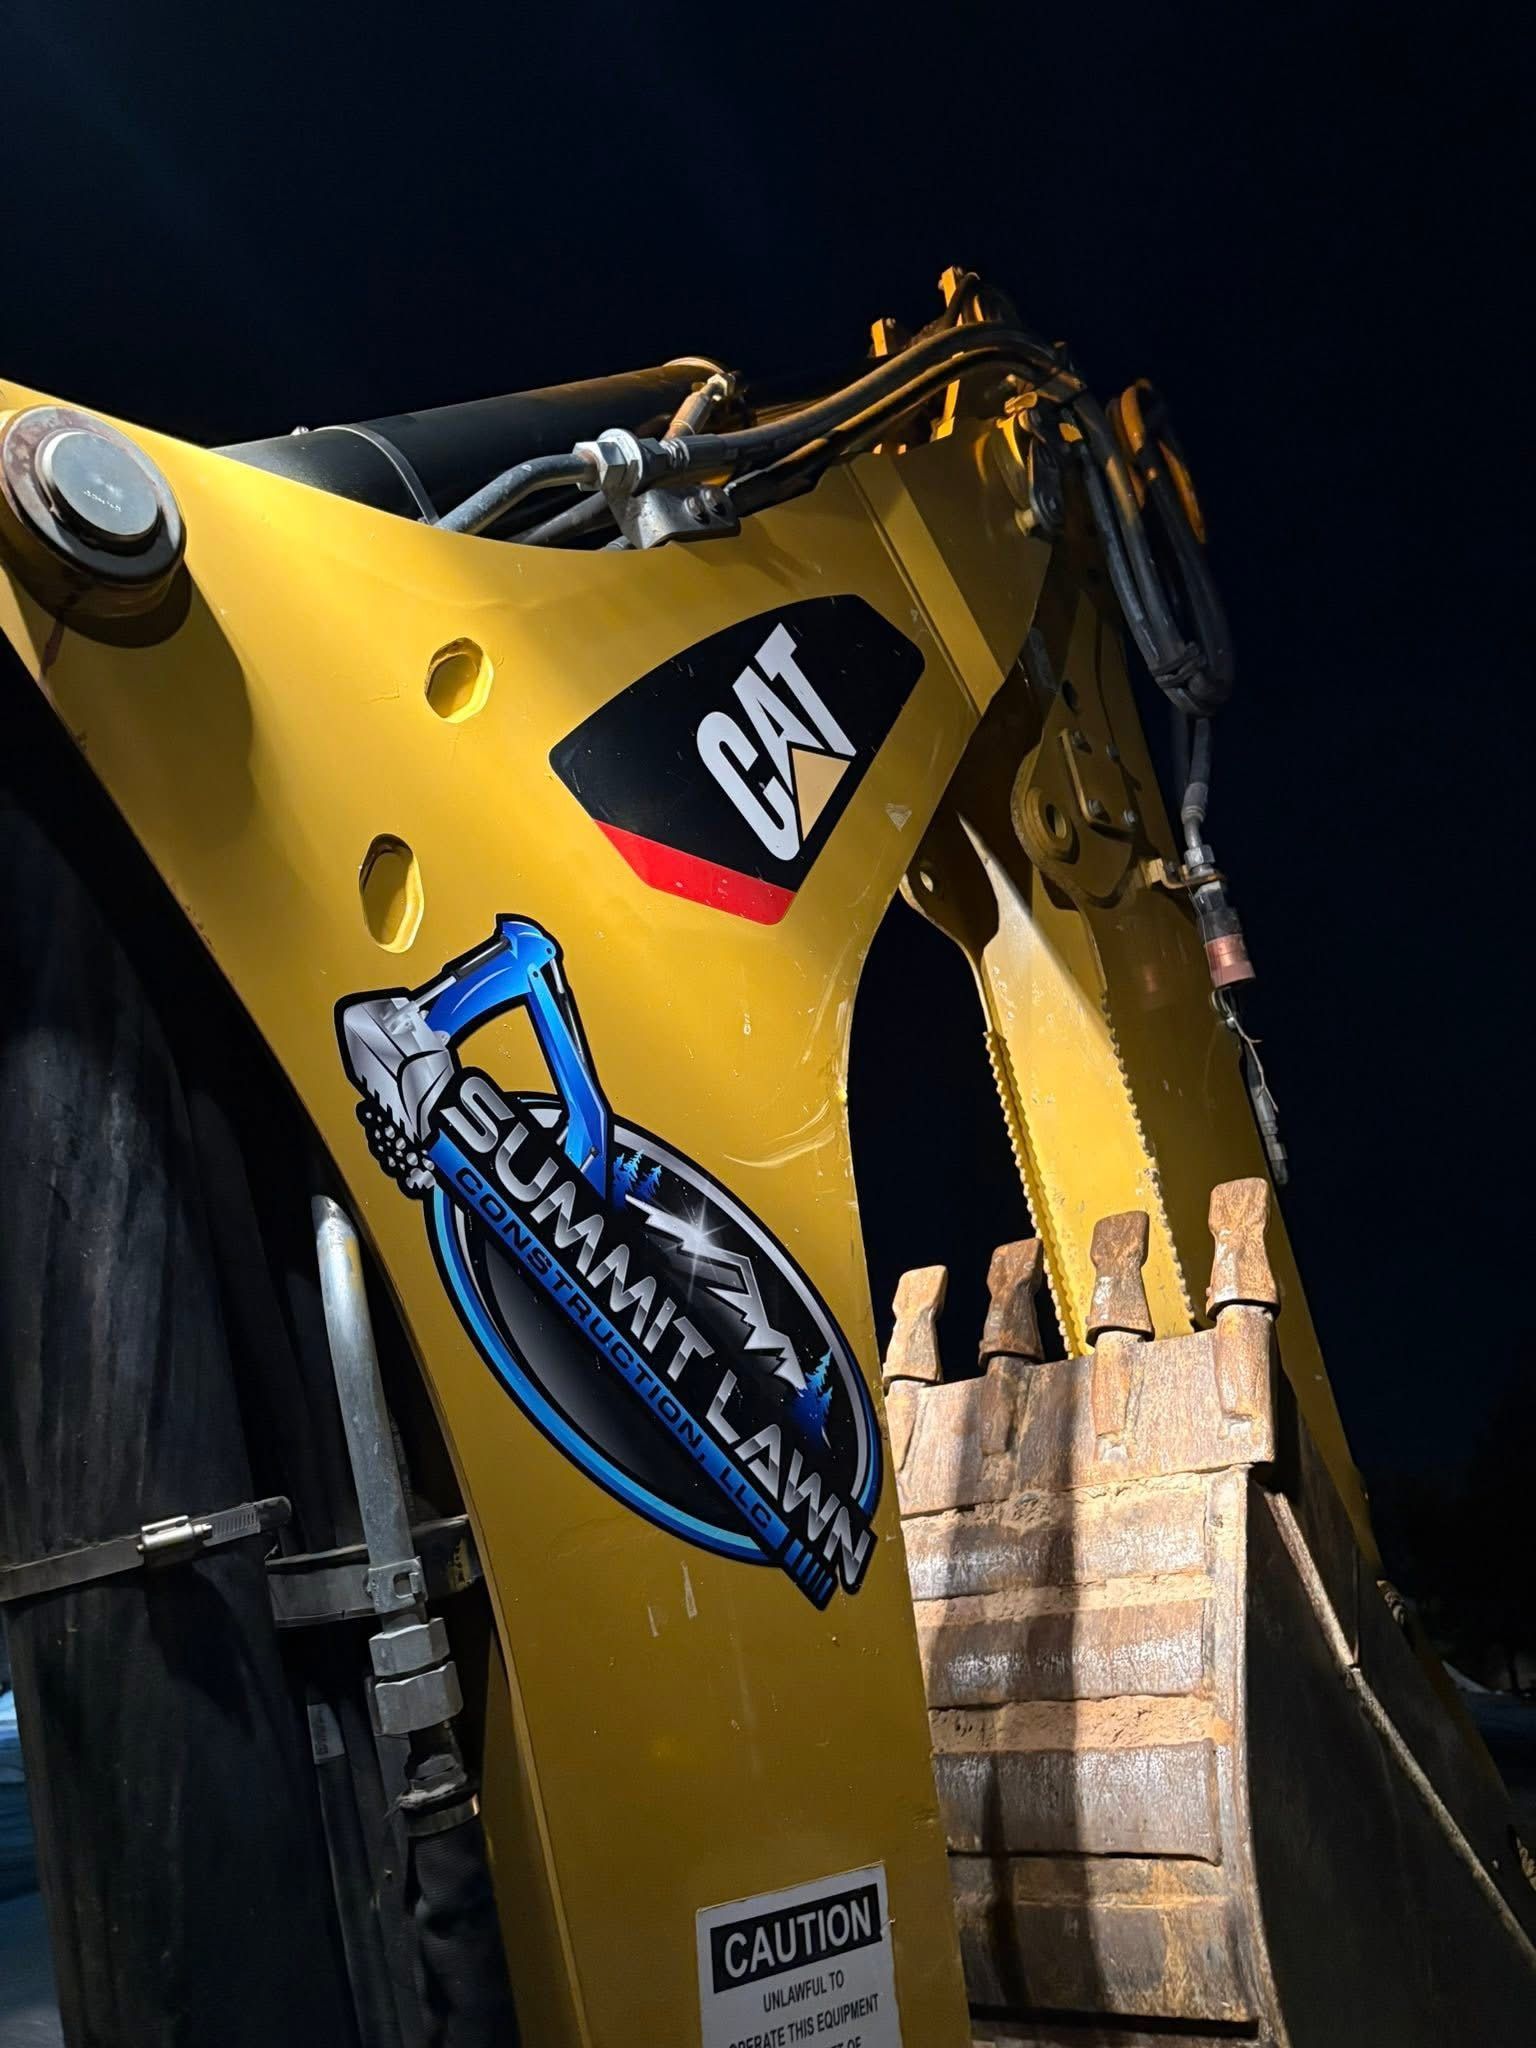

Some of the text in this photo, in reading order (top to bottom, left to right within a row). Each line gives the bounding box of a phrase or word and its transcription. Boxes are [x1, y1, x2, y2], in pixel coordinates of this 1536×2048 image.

[696, 622, 857, 861] CAT
[440, 1076, 870, 1578] SUMMIT LAWN
[719, 1466, 772, 1529] LLC
[724, 1896, 872, 1979] CAUTION
[763, 1969, 845, 2013] UNLAWFUL TO
[787, 2015, 815, 2043] THIS
[817, 1993, 879, 2033] EQUIPMENT
